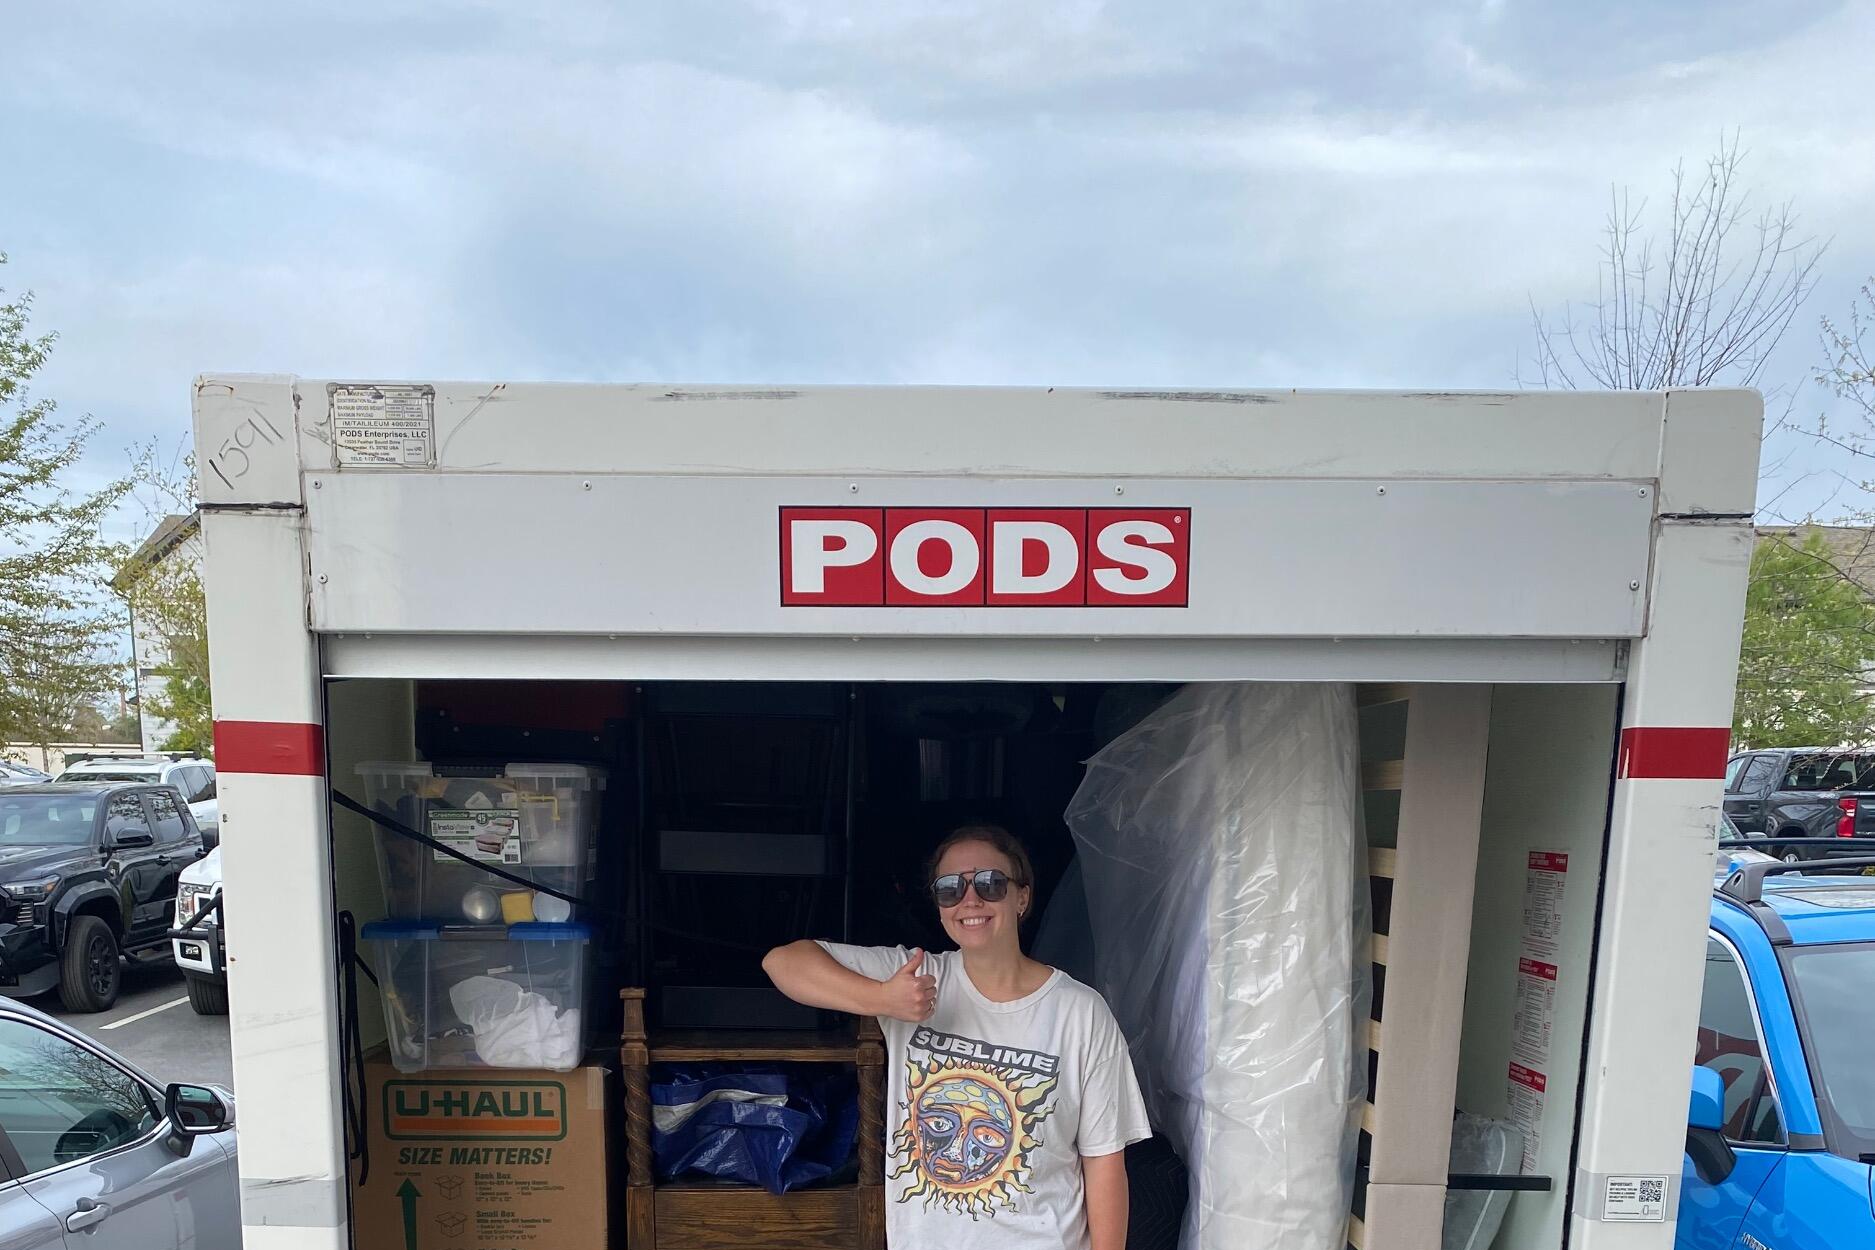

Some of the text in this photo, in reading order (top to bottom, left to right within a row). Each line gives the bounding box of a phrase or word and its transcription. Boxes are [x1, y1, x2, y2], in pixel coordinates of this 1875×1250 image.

[340, 430, 428, 439] PODS Enterprises, LLC
[790, 519, 1178, 596] PODS
[915, 1030, 1054, 1072] SUBLIME
[395, 1090, 554, 1117] U-HAUL
[398, 1148, 552, 1166] SIZE MATTERS!
[476, 1210, 515, 1218] Small Box
